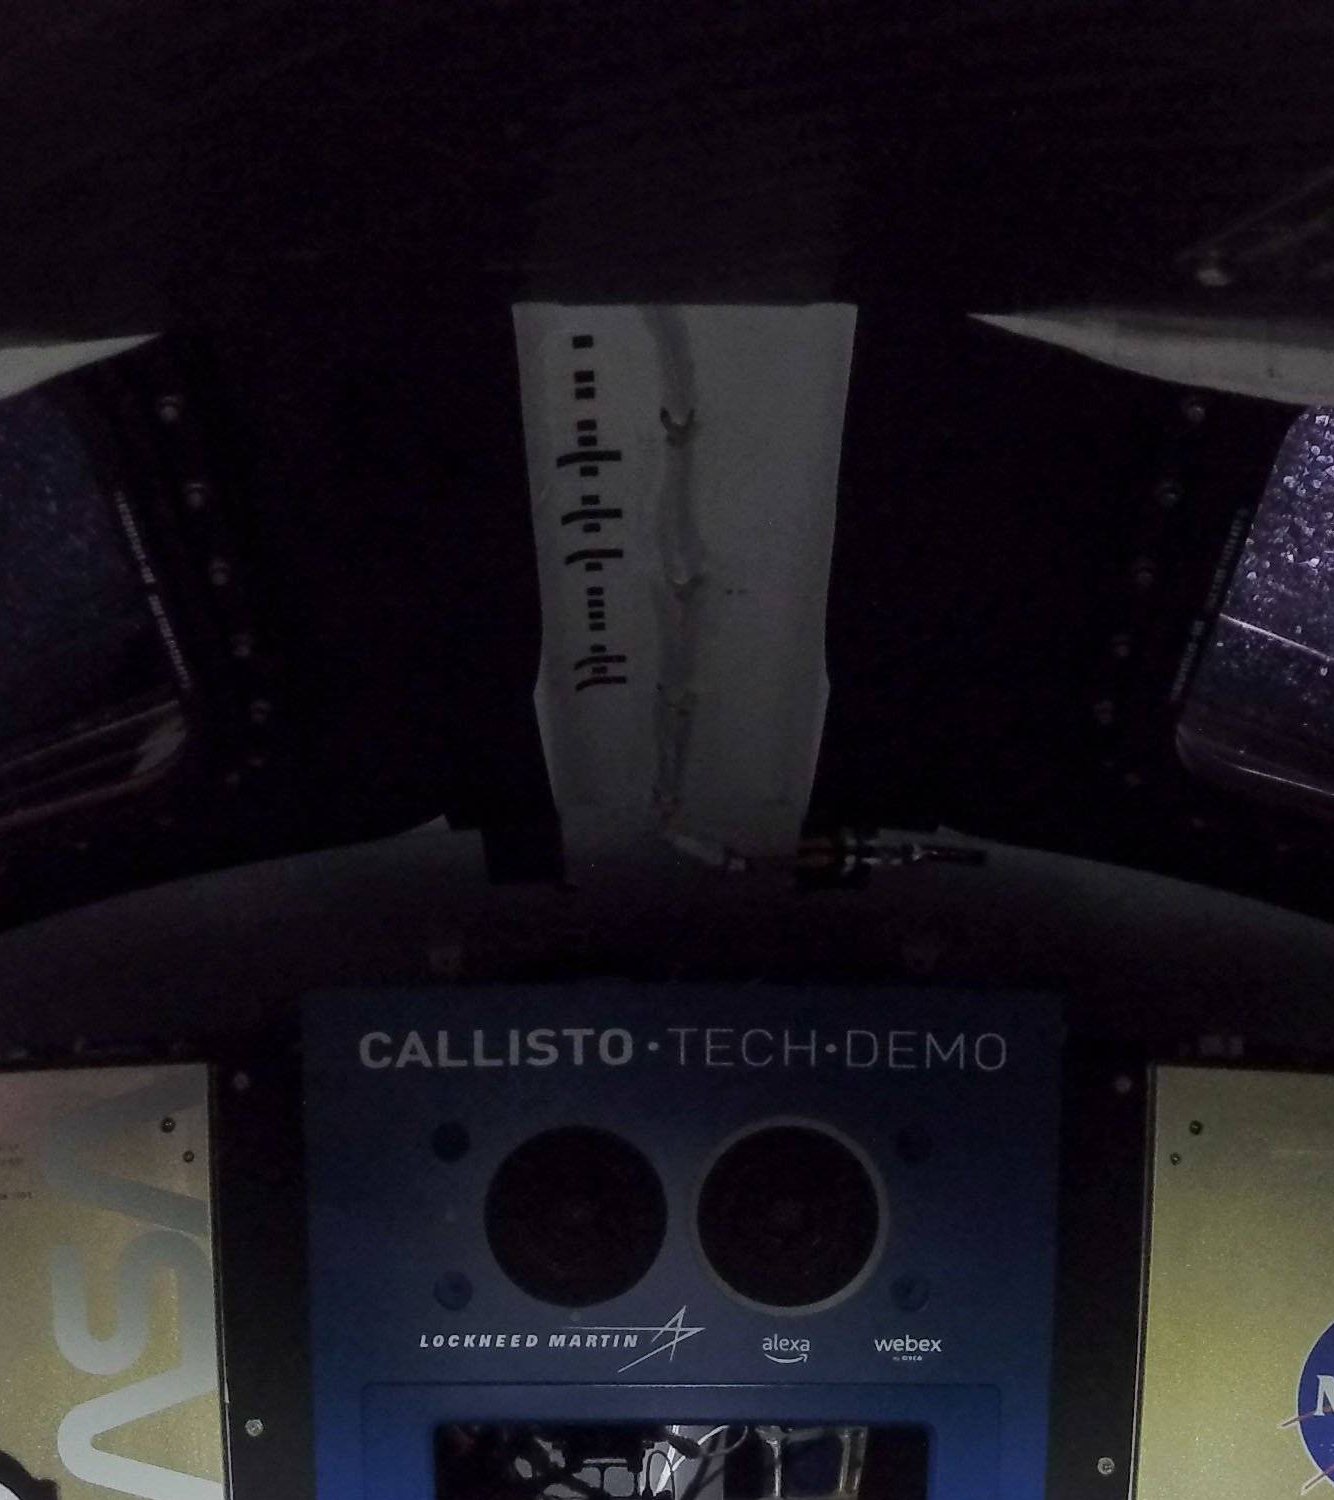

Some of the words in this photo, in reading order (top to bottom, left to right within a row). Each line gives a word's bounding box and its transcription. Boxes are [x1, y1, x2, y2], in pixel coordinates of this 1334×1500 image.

[358, 1027, 635, 1069] CALLISTO
[666, 1028, 818, 1069] TECH
[846, 1030, 1008, 1072] DEMO
[418, 1333, 540, 1349] LOCKHEED
[548, 1333, 639, 1349] MARTIN
[762, 1333, 812, 1353] alexa
[873, 1334, 943, 1353] webex
